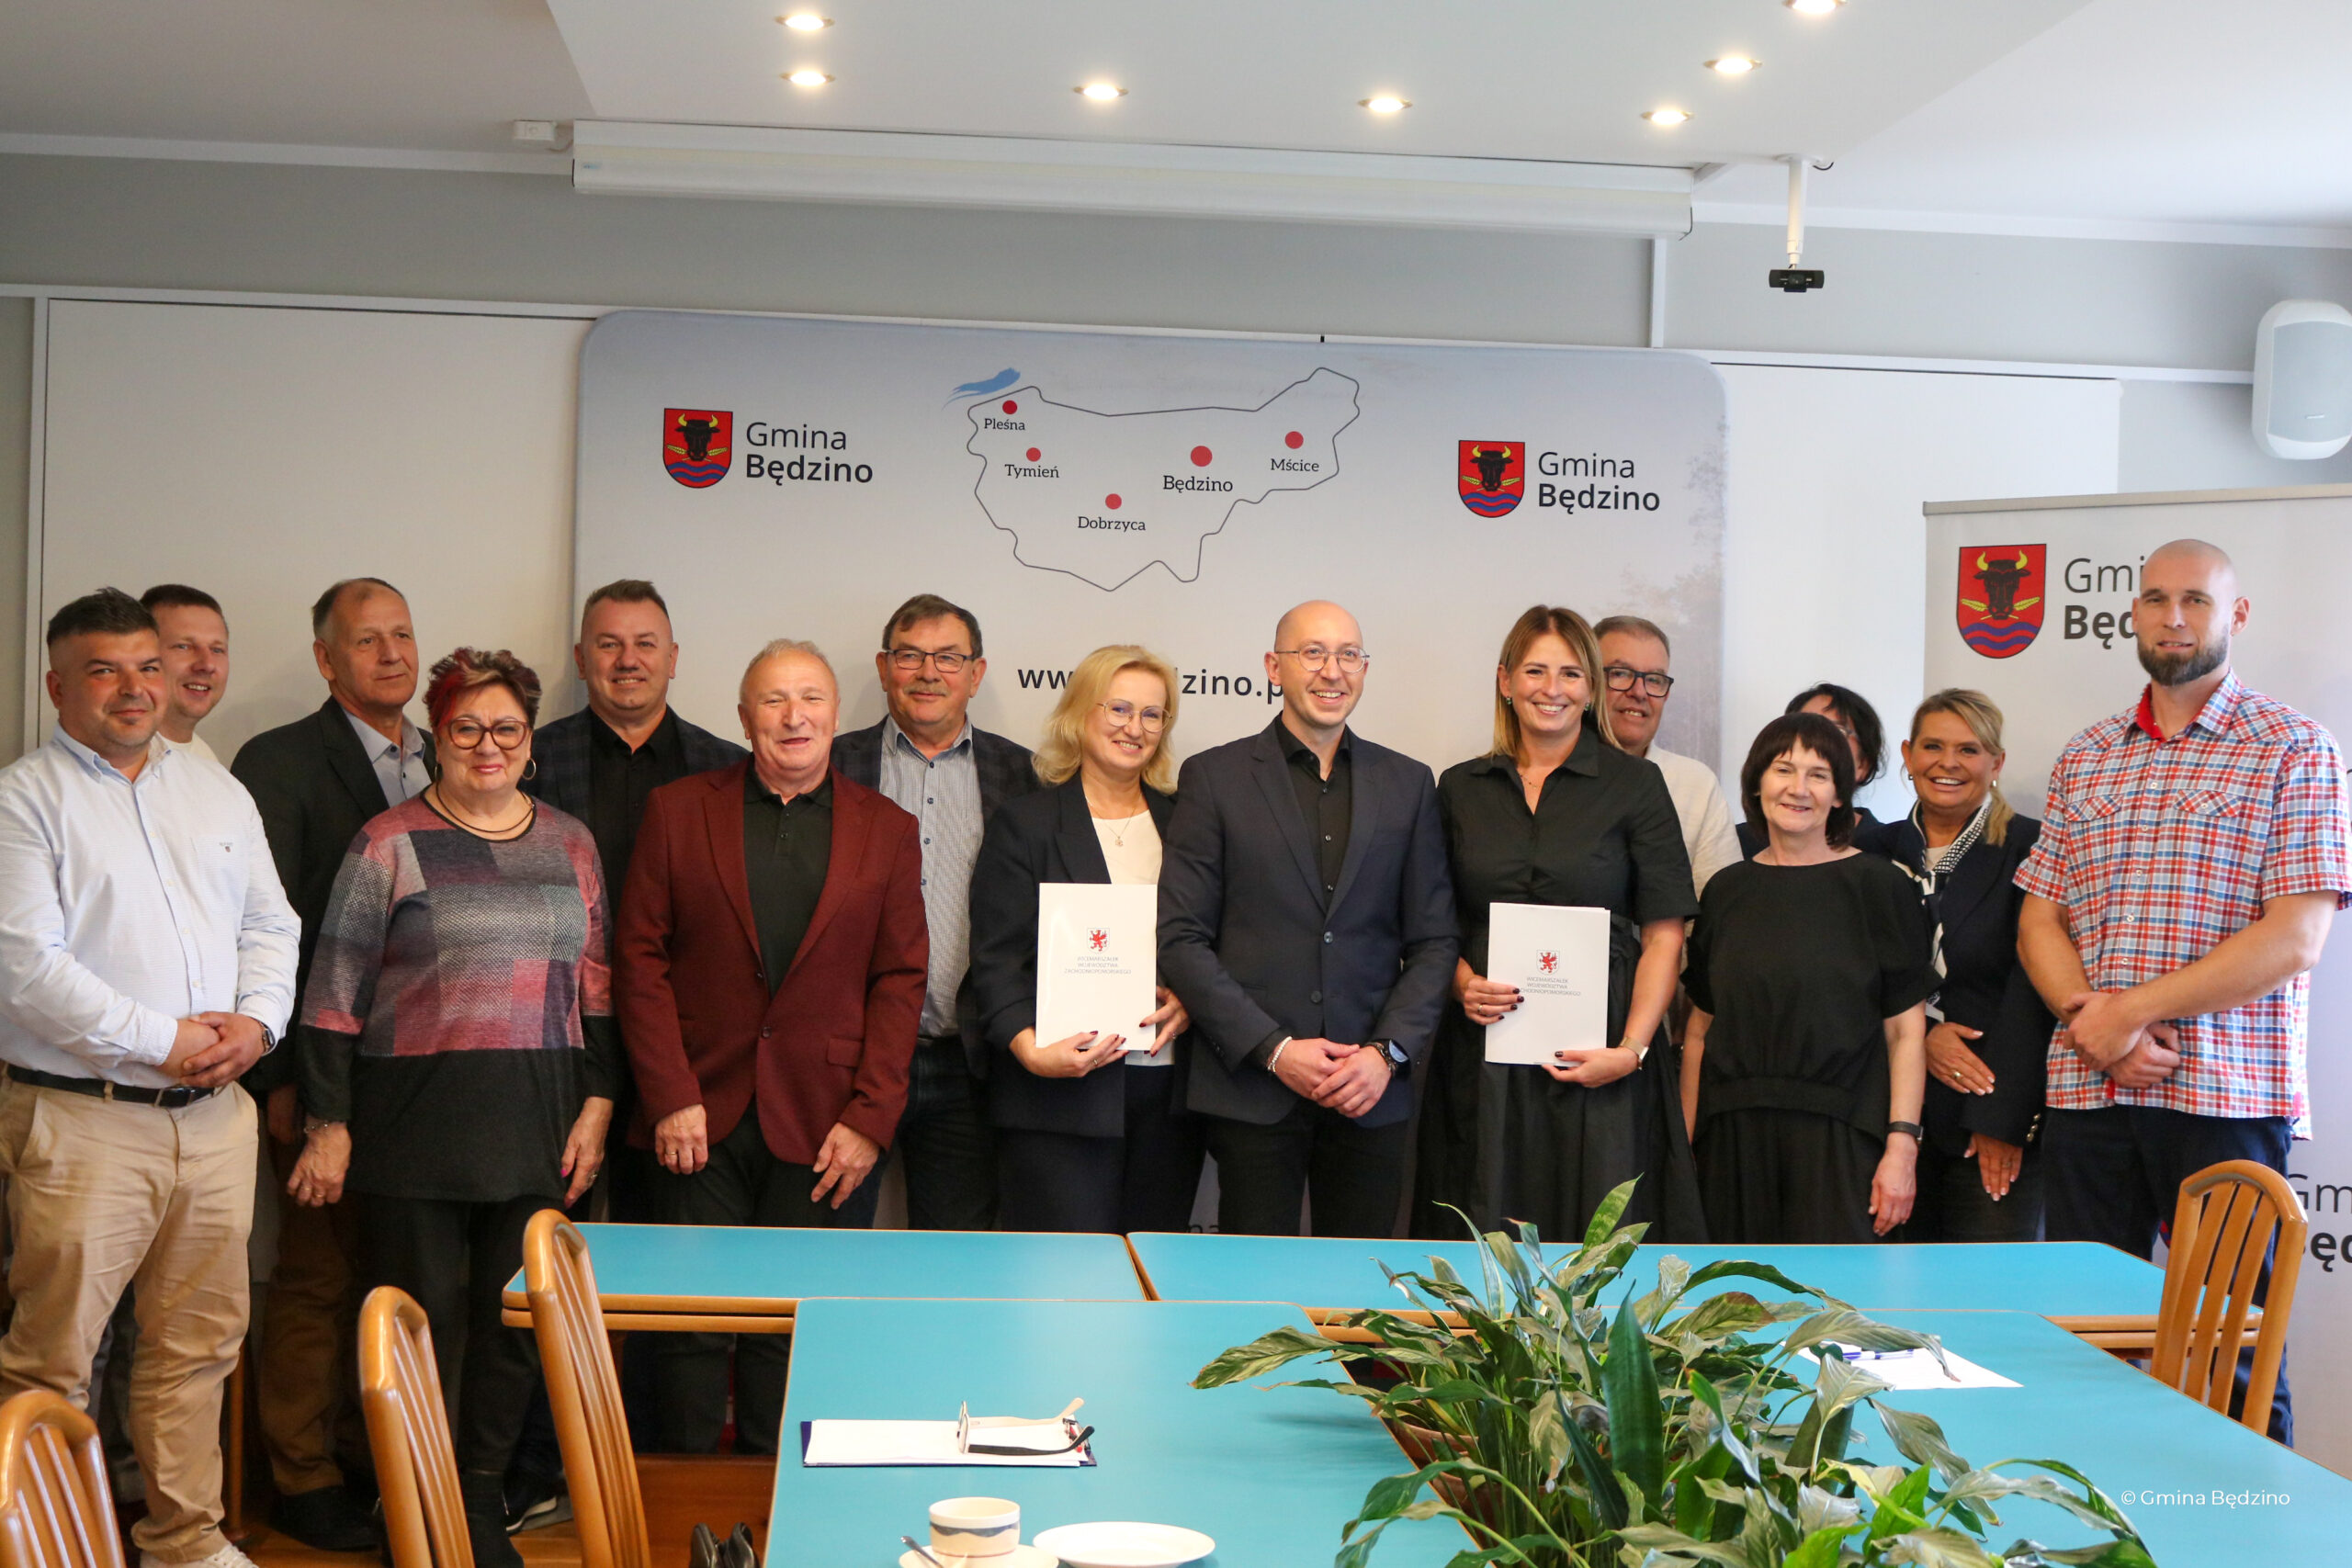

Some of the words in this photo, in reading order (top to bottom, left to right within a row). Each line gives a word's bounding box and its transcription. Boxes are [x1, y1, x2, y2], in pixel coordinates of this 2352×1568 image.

[983, 417, 1026, 431] Pleśna
[745, 422, 847, 451] Gmina
[745, 453, 874, 487] Będzino
[1004, 463, 1060, 479] Tymień
[1270, 457, 1320, 472] Mścice
[1538, 451, 1635, 479] Gmina
[1162, 474, 1234, 494] Będzino
[1538, 482, 1661, 515] Będzino
[1077, 515, 1147, 534] Dobrzyca
